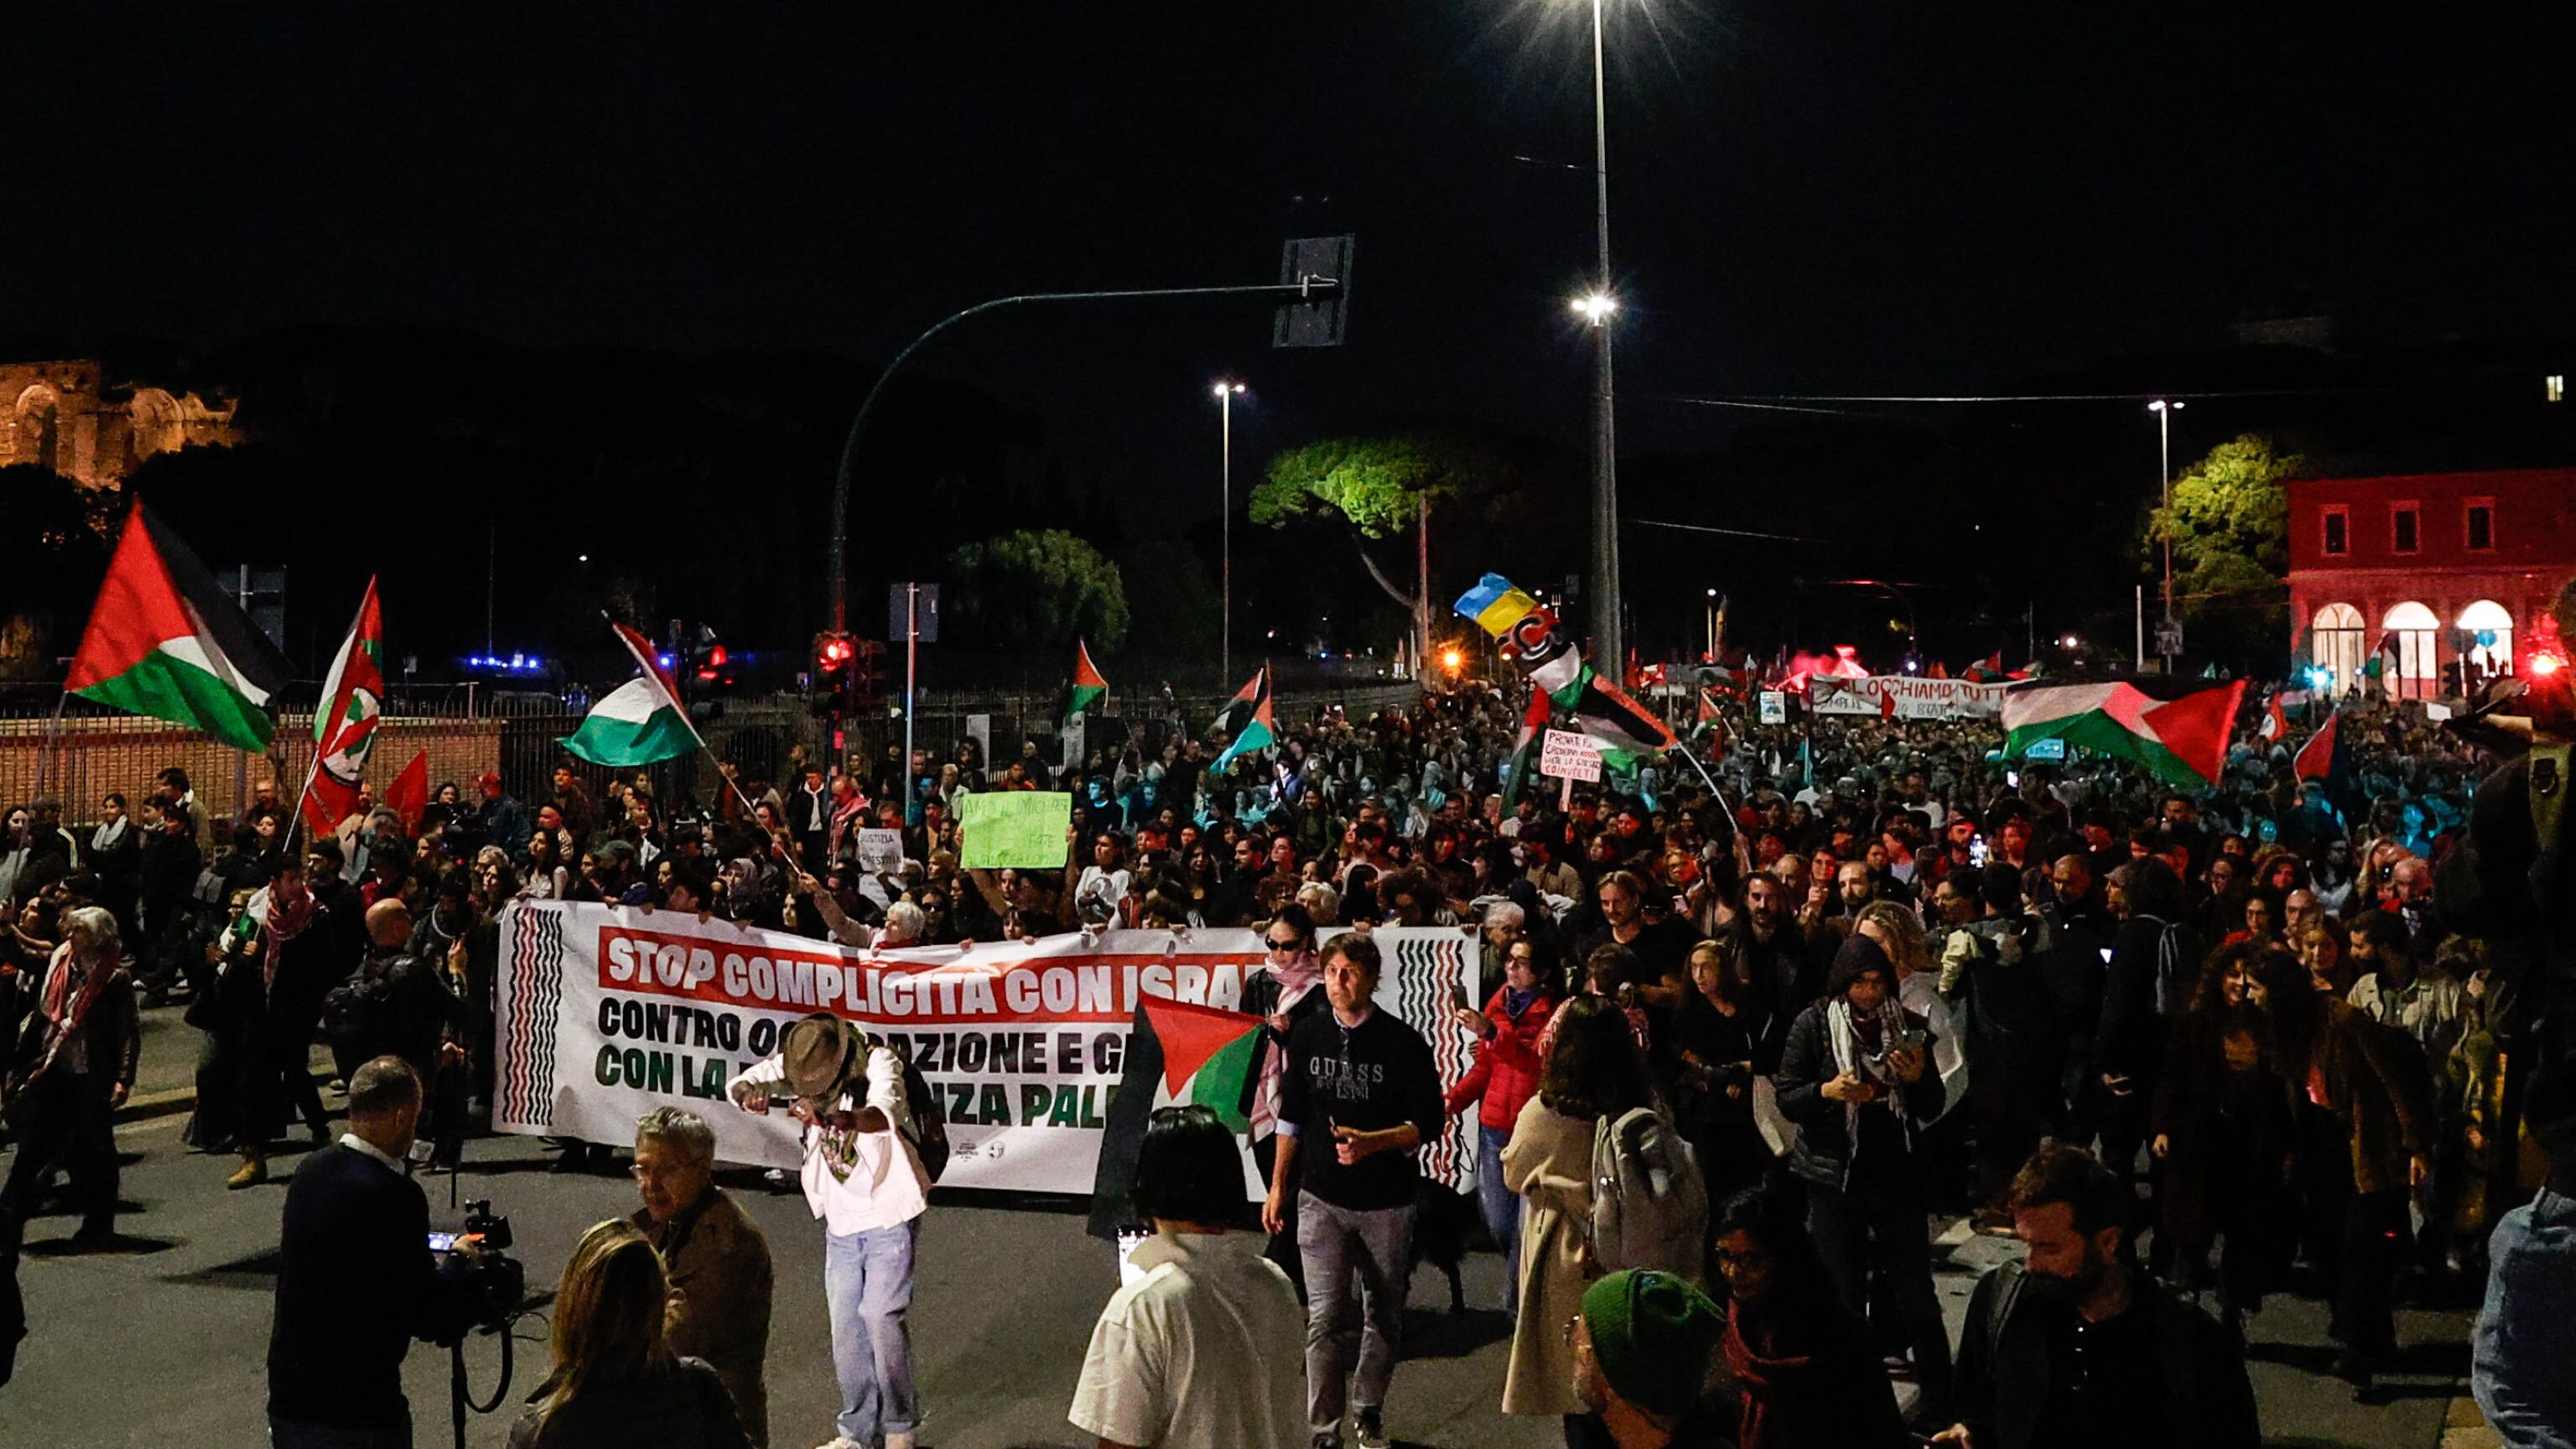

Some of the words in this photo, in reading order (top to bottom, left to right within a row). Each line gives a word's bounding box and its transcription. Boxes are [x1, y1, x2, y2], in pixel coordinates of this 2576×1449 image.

[608, 937, 716, 989] STOP
[1005, 965, 1113, 1014] CON
[595, 1044, 673, 1093] CON
[682, 1055, 727, 1102] LA
[598, 997, 740, 1052] CONTRO
[1057, 1032, 1083, 1073] E
